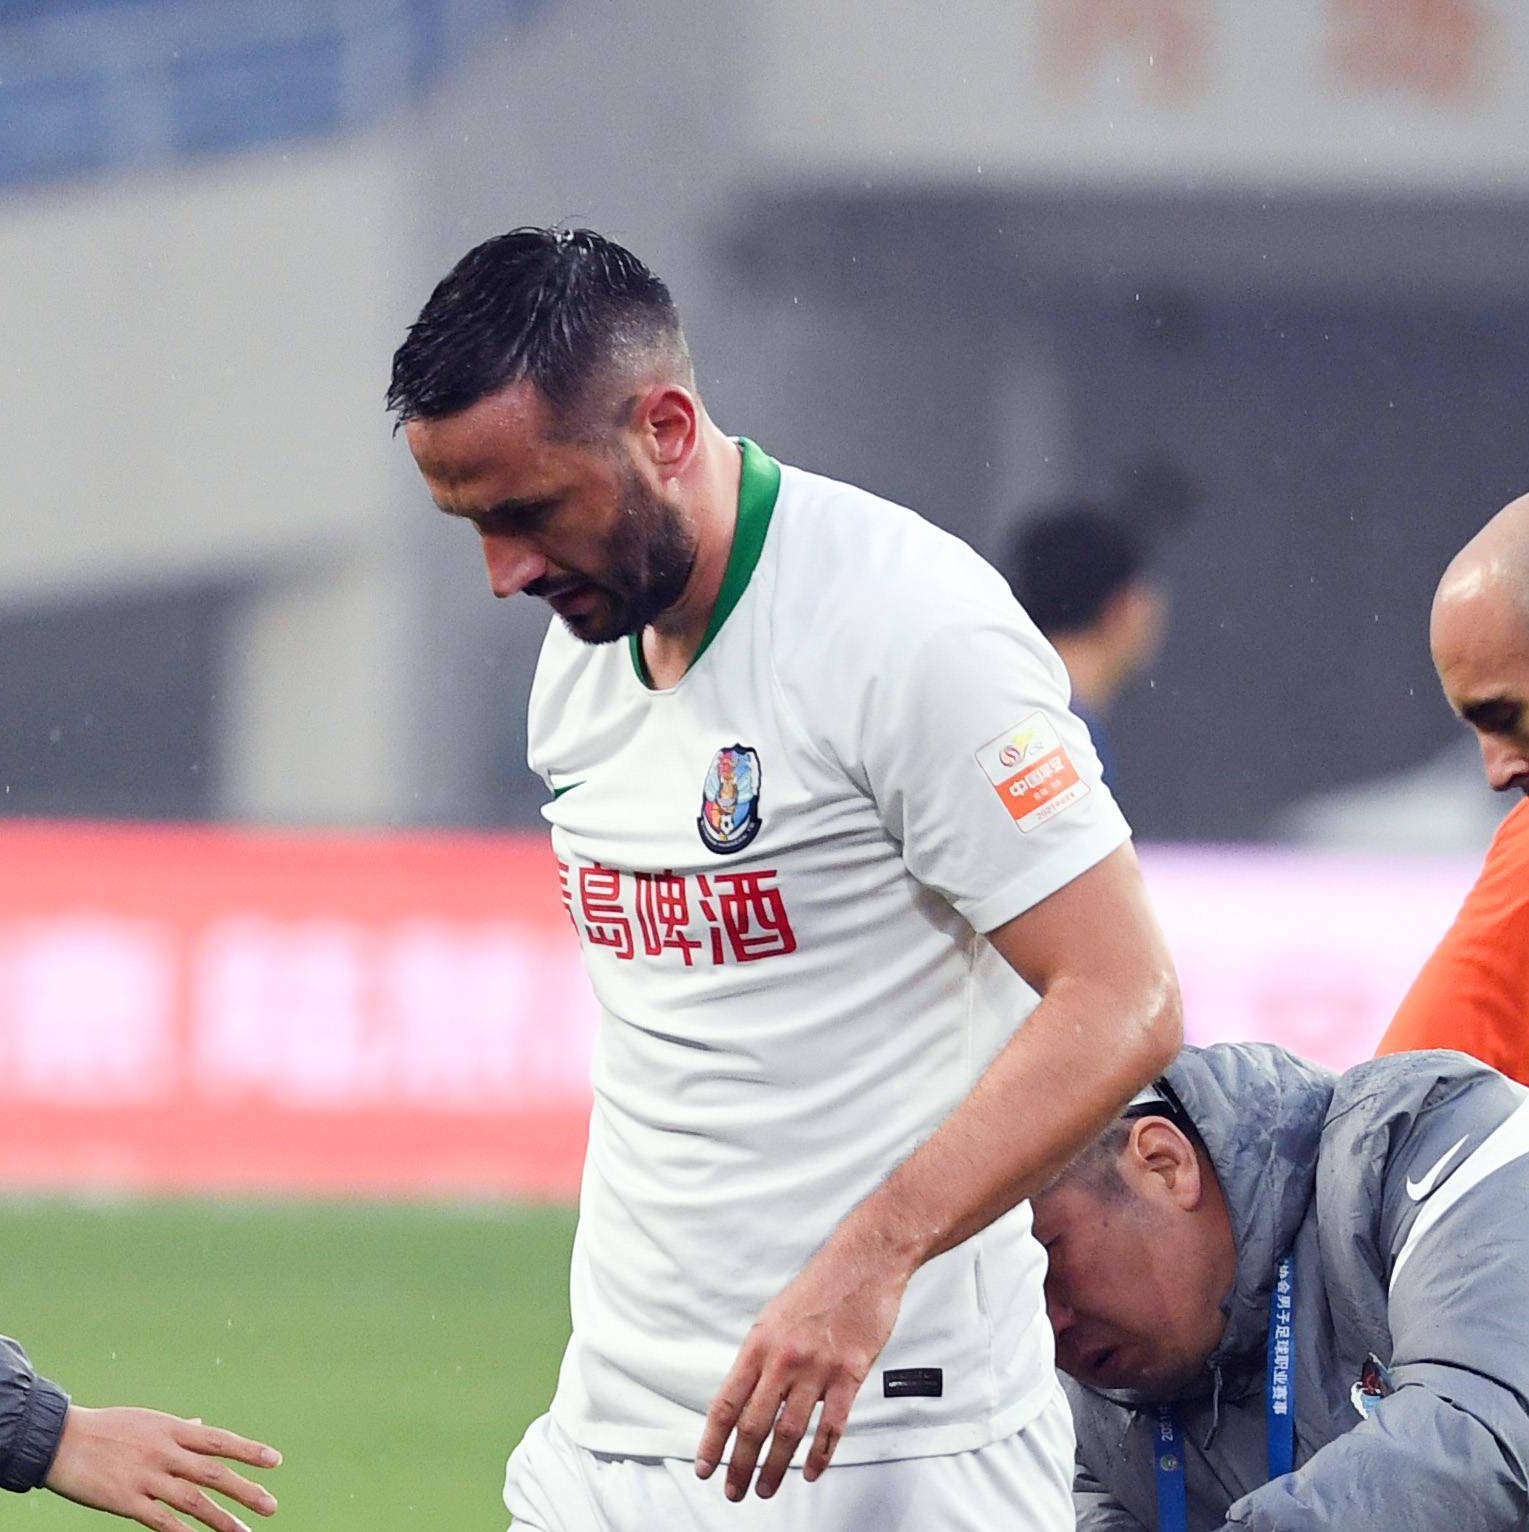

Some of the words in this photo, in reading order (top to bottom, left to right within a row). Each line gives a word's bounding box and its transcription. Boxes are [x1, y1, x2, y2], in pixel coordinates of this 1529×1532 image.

[557, 862, 797, 966] 島啤酒
[1271, 1260, 1292, 1415] 协会男子足球职业赛事
